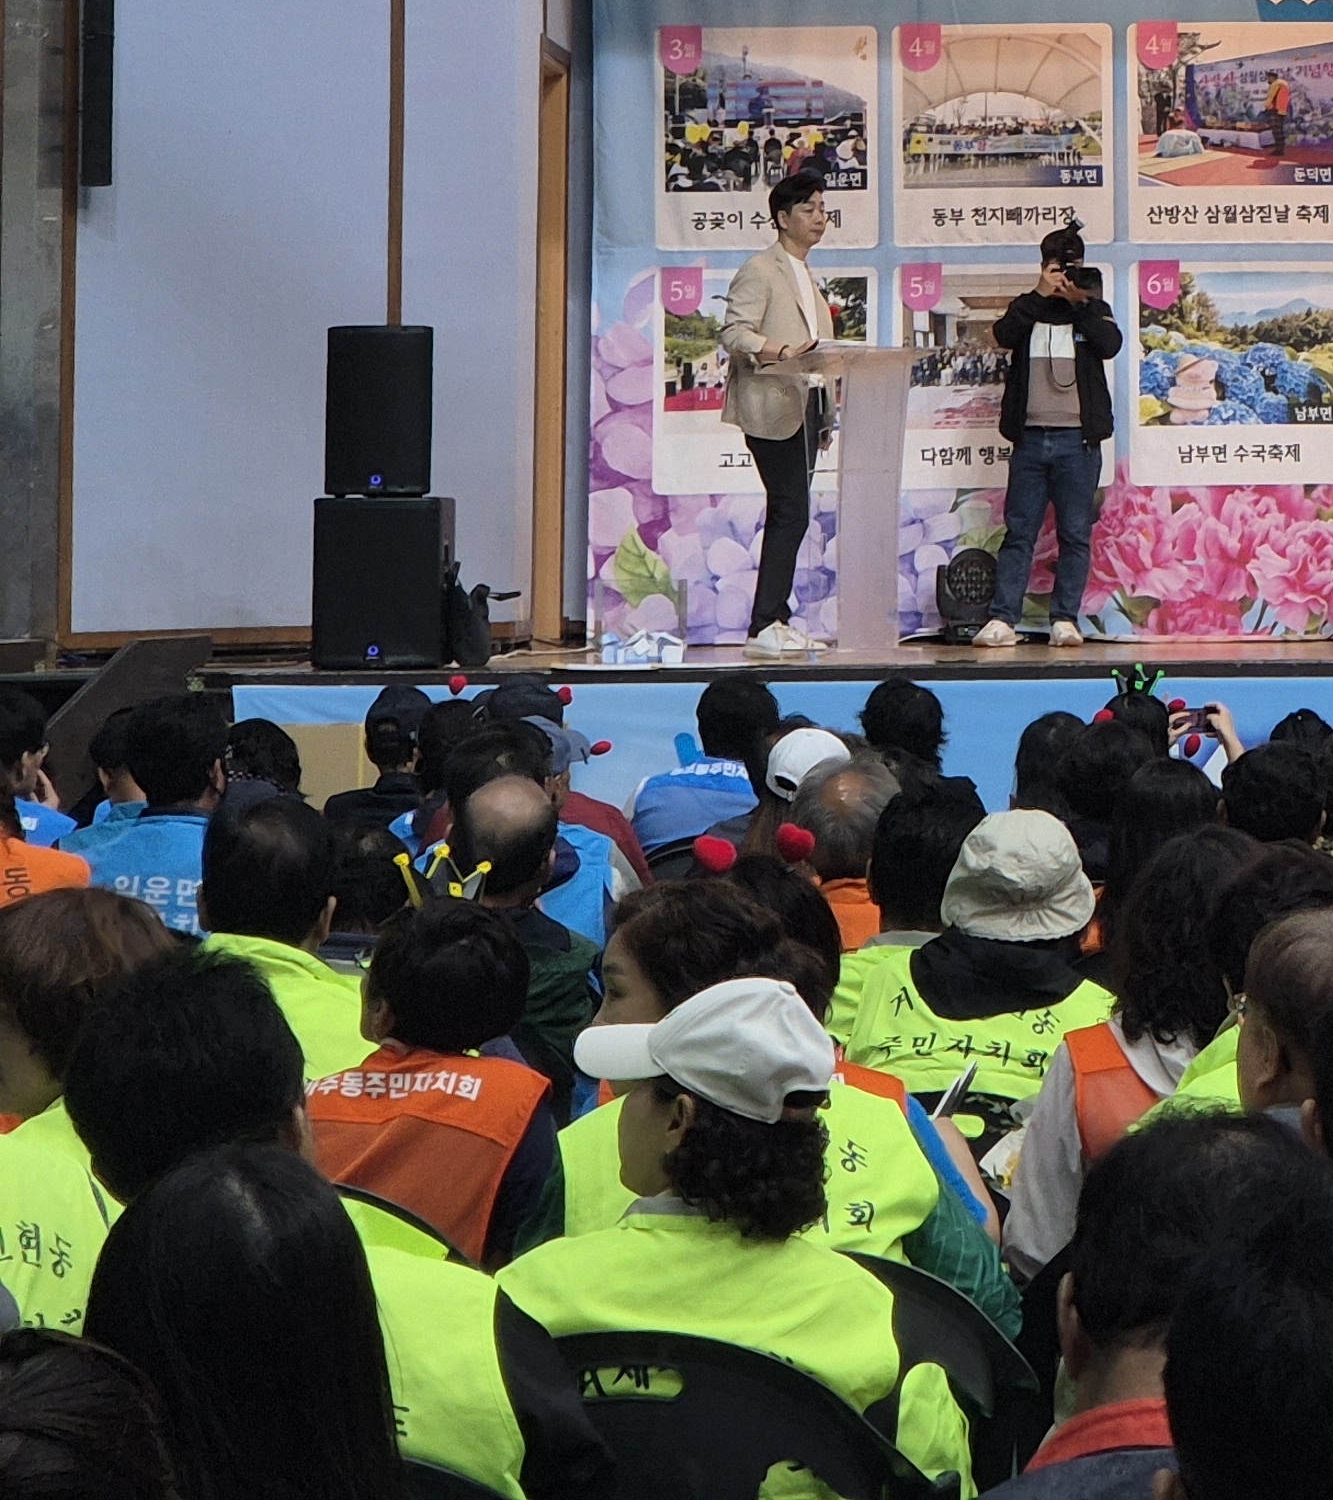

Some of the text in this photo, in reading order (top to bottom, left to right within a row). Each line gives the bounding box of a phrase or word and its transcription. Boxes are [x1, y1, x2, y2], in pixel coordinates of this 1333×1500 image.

[669, 39, 695, 59] 3월
[908, 36, 936, 57] 4월
[1145, 35, 1172, 53] 4월
[692, 211, 743, 230] 공곶이
[932, 208, 966, 226] 동부
[1147, 204, 1329, 224] 산방산 삼월삼짇날 축제
[670, 281, 695, 301] 5월
[910, 277, 935, 297] 5월
[1147, 273, 1174, 293] 6월
[1295, 406, 1332, 421] 남부면
[921, 446, 971, 466] 다함께
[1178, 444, 1300, 463] 남부면 수국축제
[872, 1032, 1048, 1077] 주민자치회
